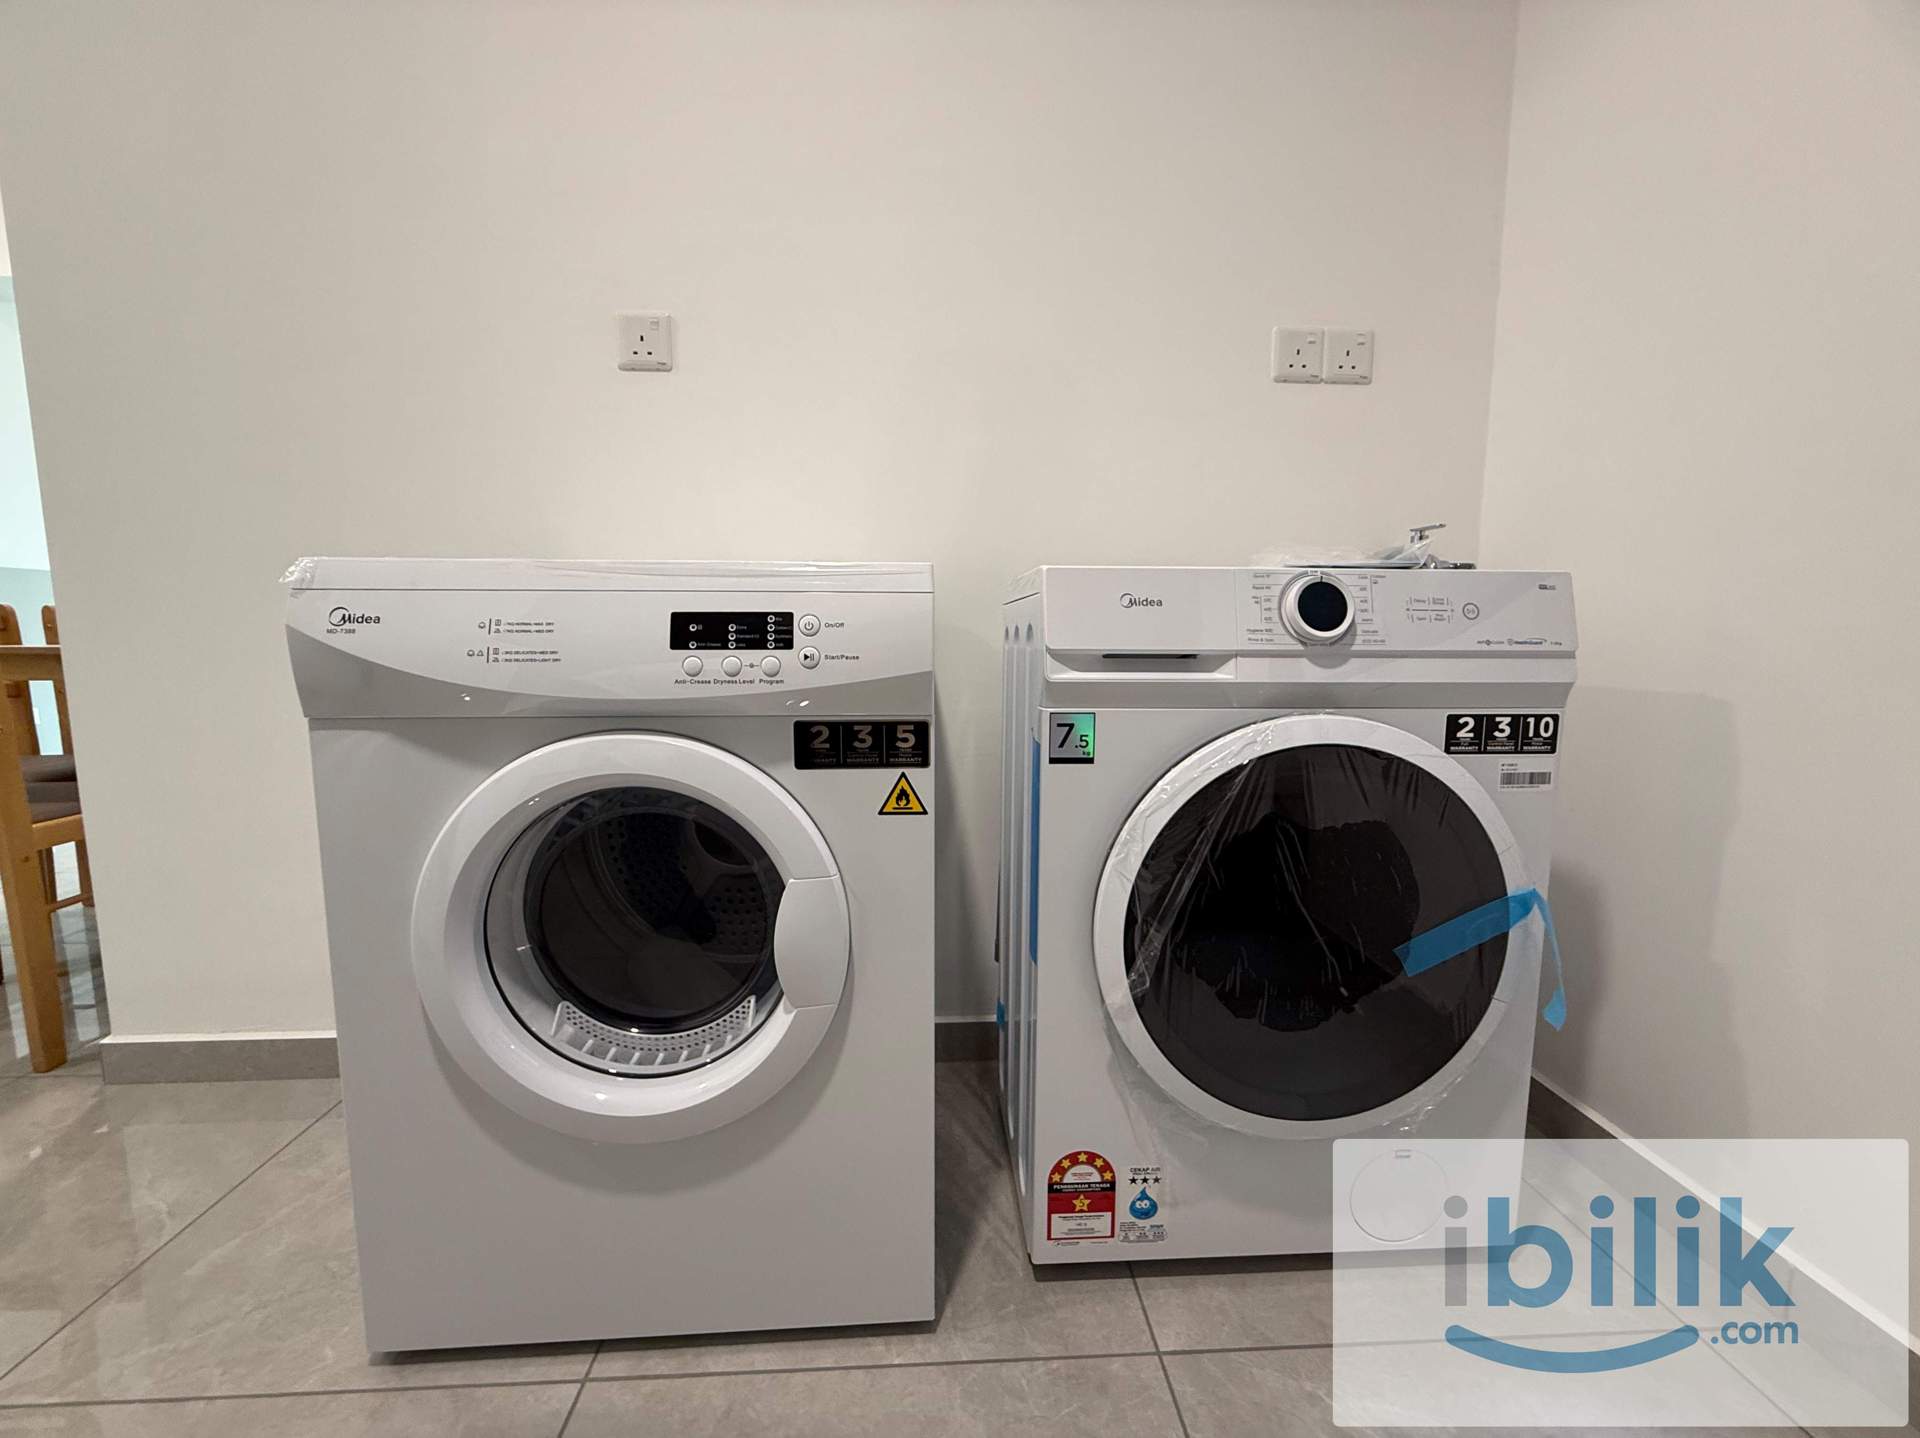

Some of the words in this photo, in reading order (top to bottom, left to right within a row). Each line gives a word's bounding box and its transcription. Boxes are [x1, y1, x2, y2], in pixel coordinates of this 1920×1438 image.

[1120, 593, 1163, 608] Midea
[328, 606, 381, 626] Midea
[713, 678, 738, 686] Dryness
[759, 678, 785, 686] Program
[809, 725, 830, 749] 2
[852, 725, 873, 748] 3
[895, 724, 916, 748] 5
[1056, 722, 1090, 749] 7.5
[1456, 716, 1475, 738] 2
[1493, 716, 1512, 738] 3
[1526, 716, 1554, 738] 10
[1078, 1198, 1085, 1208] 5
